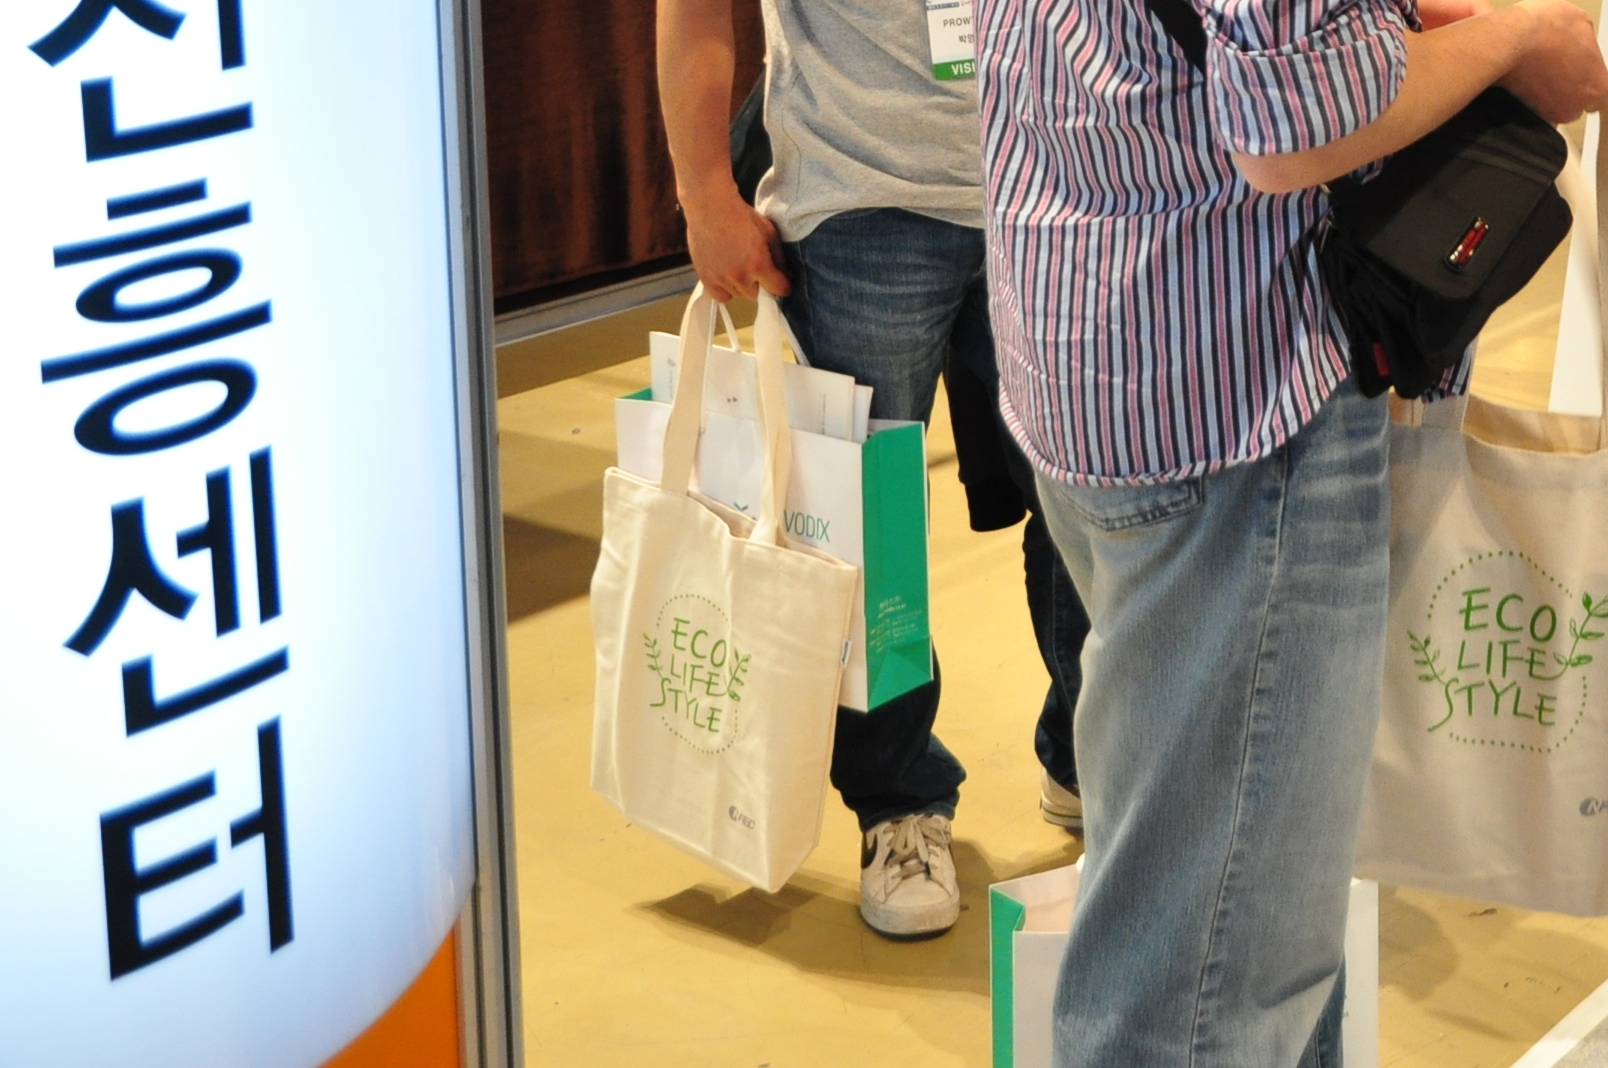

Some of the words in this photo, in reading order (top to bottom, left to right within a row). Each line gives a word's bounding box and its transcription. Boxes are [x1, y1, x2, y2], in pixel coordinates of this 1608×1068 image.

[1459, 587, 1558, 643] ECO
[672, 617, 727, 668] ECO
[1457, 638, 1560, 681] LIFE
[669, 653, 729, 698] LIFE
[650, 676, 723, 733] STYLE
[1427, 678, 1558, 733] STYLE
